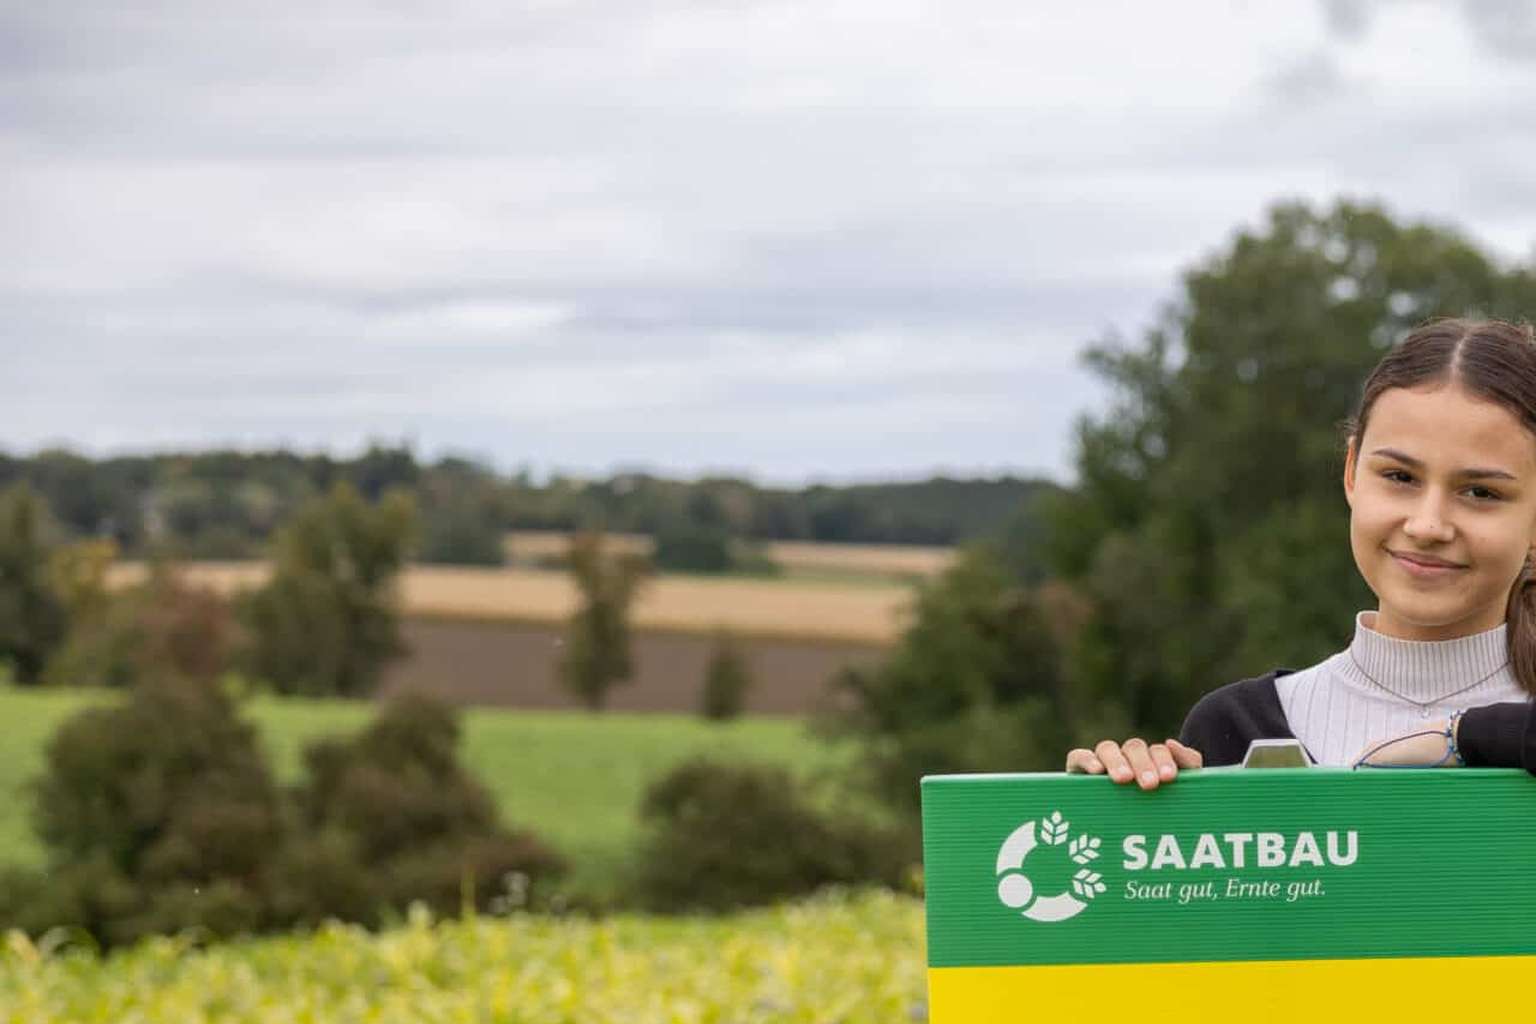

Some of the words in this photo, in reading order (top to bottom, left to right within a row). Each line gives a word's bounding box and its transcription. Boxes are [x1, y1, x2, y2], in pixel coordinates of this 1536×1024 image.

[1122, 831, 1359, 871] SAATBAU
[1123, 879, 1173, 900] Saat
[1178, 881, 1219, 905] gut,
[1225, 878, 1281, 899] Ernte
[1286, 879, 1327, 904] gut.
